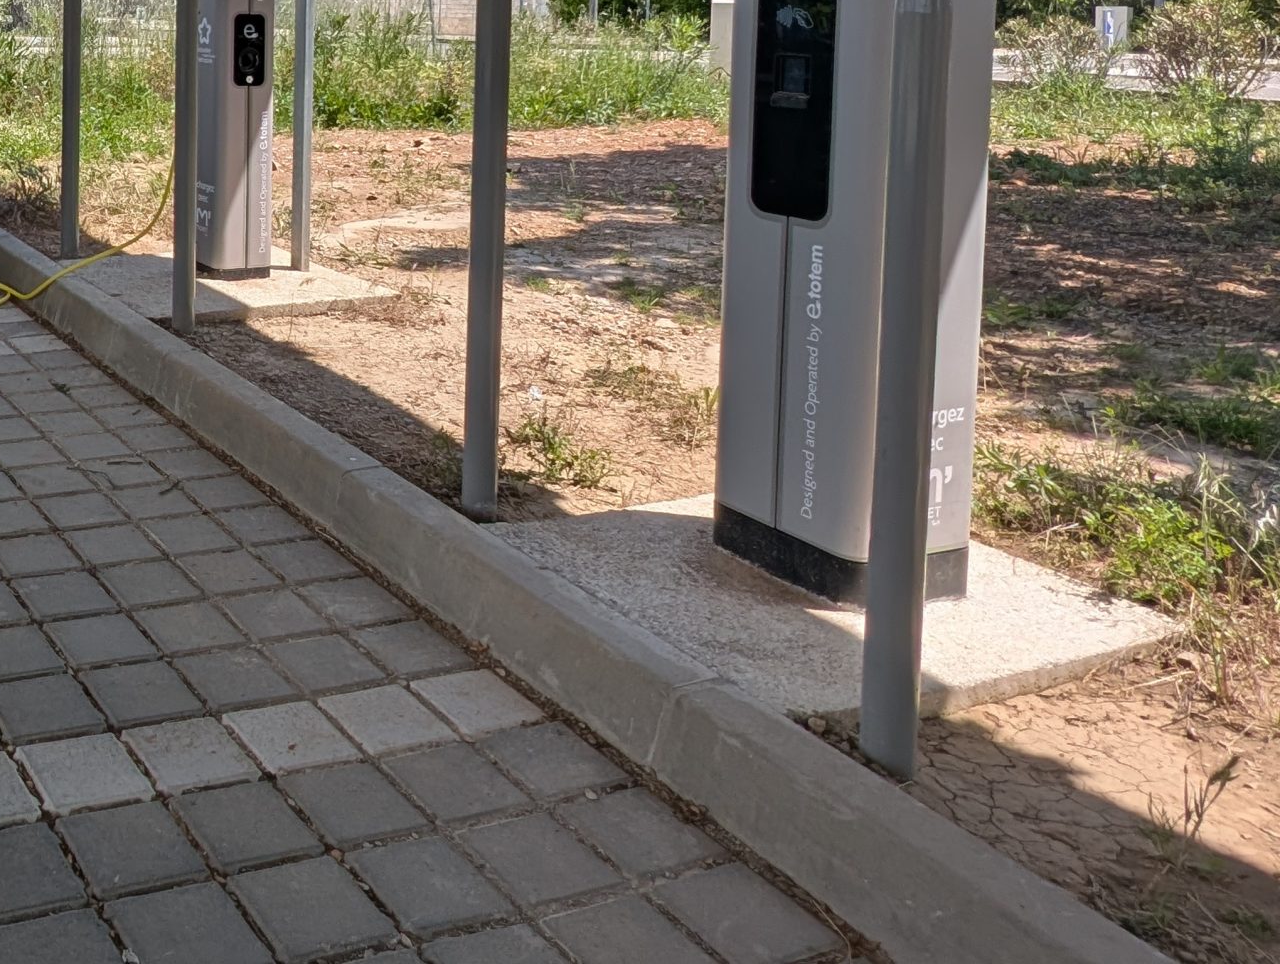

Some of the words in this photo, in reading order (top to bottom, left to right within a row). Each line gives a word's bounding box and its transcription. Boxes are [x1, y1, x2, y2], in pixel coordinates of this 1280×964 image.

[259, 163, 268, 199] Operated
[259, 217, 268, 252] Designed
[806, 323, 823, 342] by
[804, 345, 820, 415] Operated
[803, 418, 816, 447] and
[800, 449, 817, 519] Designed
